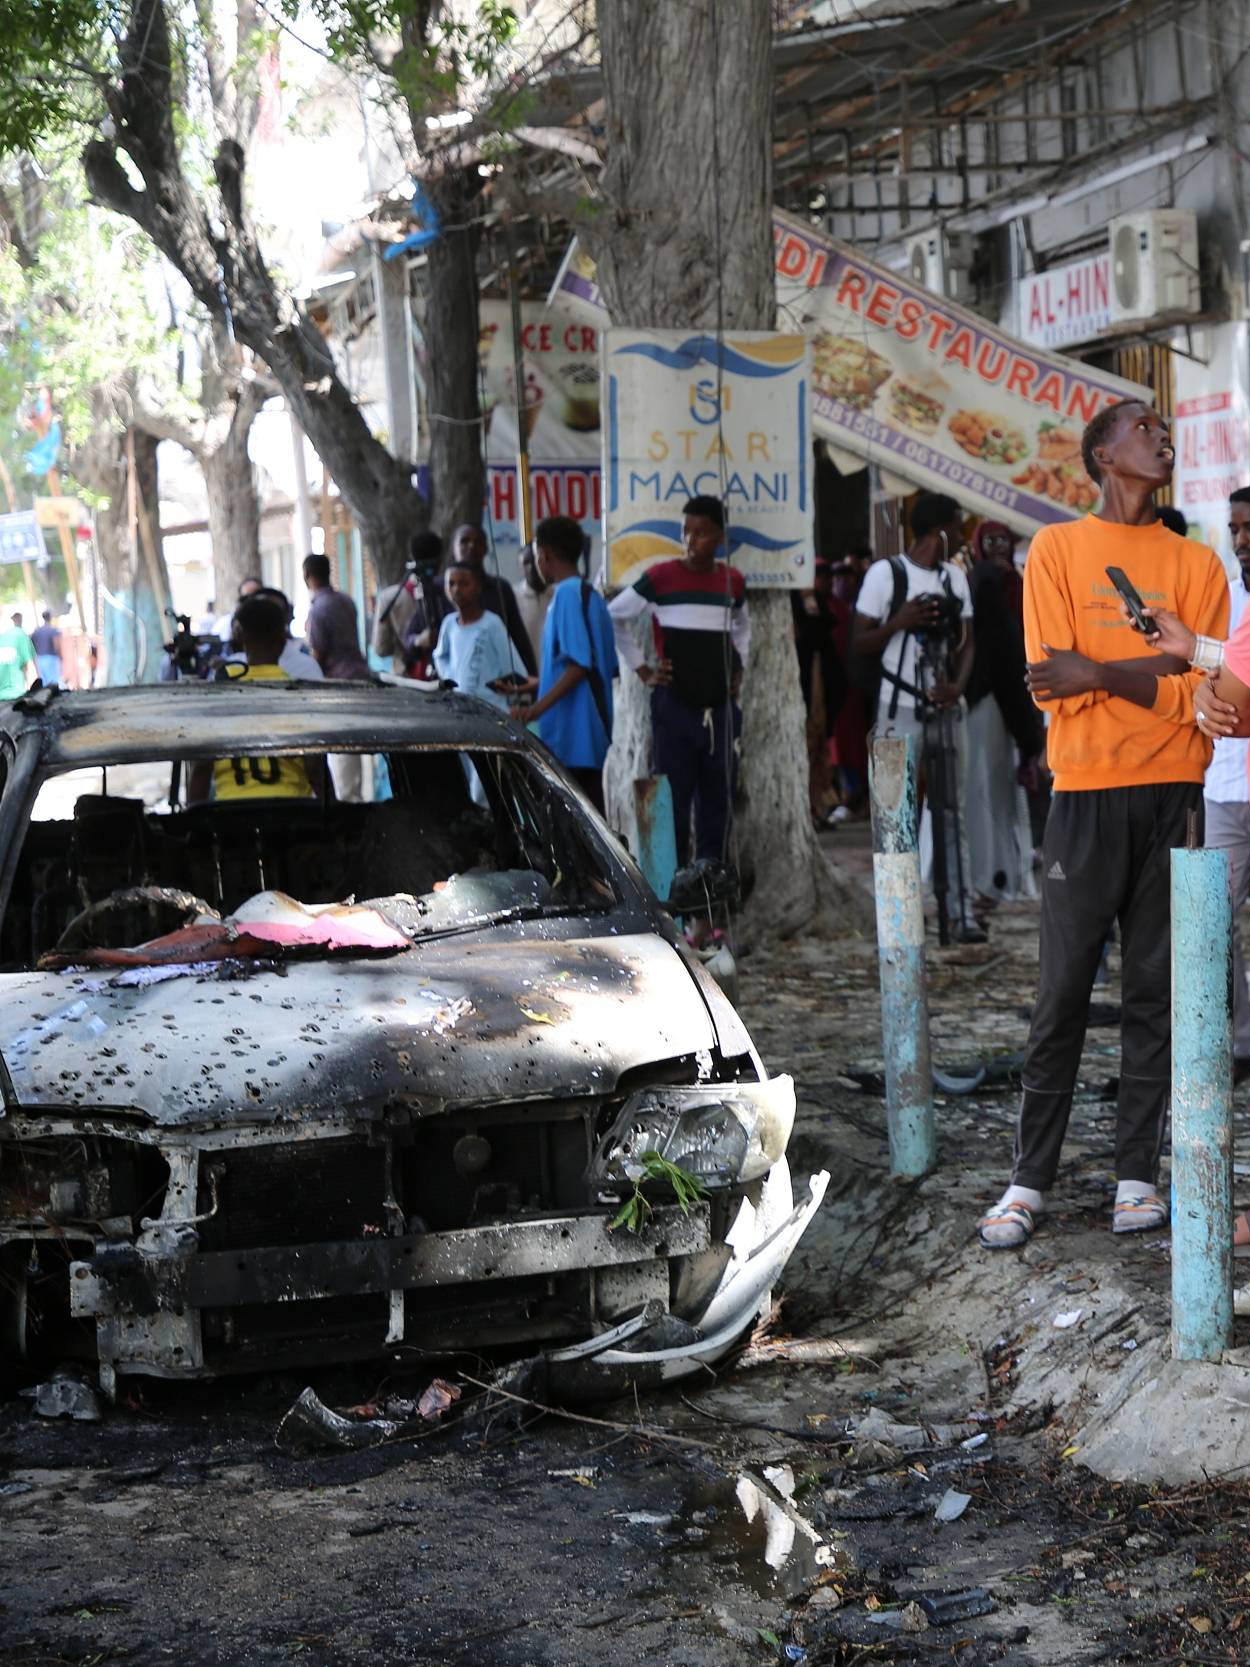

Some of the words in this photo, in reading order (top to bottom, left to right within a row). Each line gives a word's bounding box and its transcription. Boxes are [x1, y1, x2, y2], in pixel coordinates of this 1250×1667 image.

[1029, 258, 1110, 333] AL-HIN
[520, 324, 555, 352] CE
[563, 325, 597, 352] CR
[774, 226, 826, 289] DI
[836, 267, 1119, 424] RESTAURAN
[647, 430, 772, 464] STAR
[492, 472, 601, 521] HNDI
[629, 470, 788, 502] MACANI
